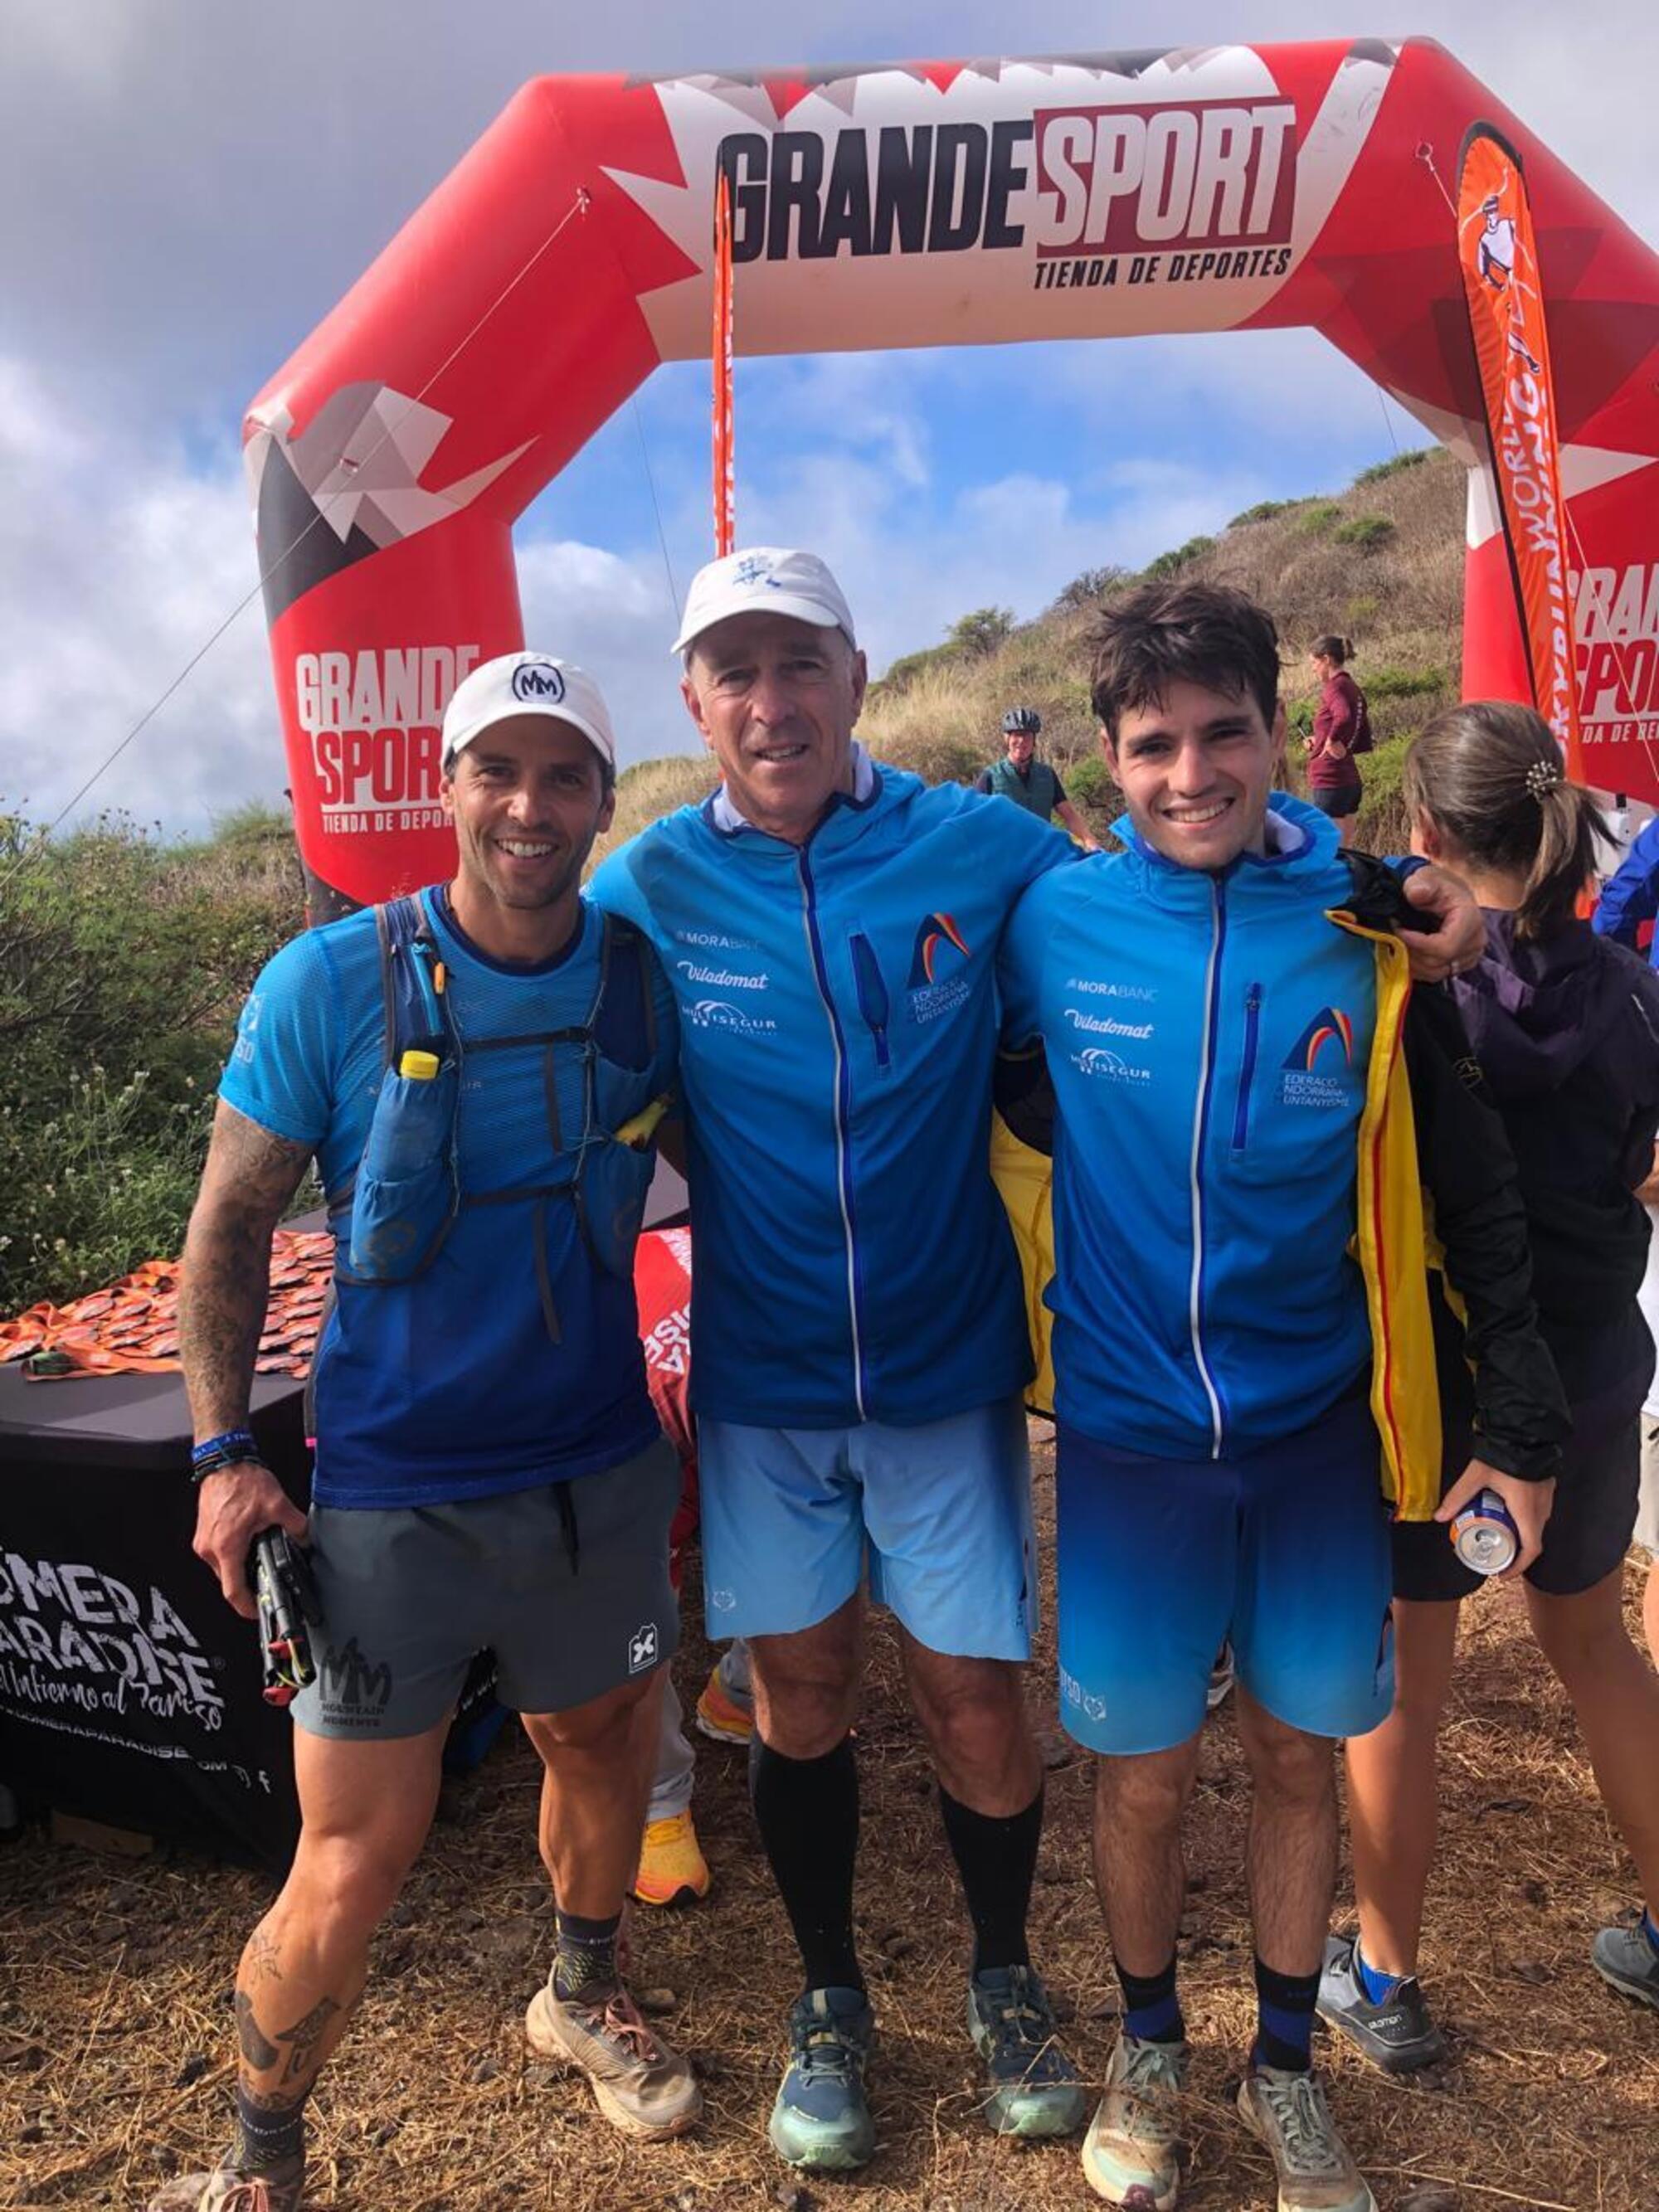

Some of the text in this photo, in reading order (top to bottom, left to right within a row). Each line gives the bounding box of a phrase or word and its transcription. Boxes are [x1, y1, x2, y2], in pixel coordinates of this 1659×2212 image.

[1034, 248, 1292, 289] TIENDA DE DEPORTES
[316, 727, 441, 805] SPOR
[323, 813, 368, 834] TIENDA
[375, 811, 393, 832] DE
[677, 960, 770, 989] Viladomat
[1064, 1009, 1154, 1039] Viladomat
